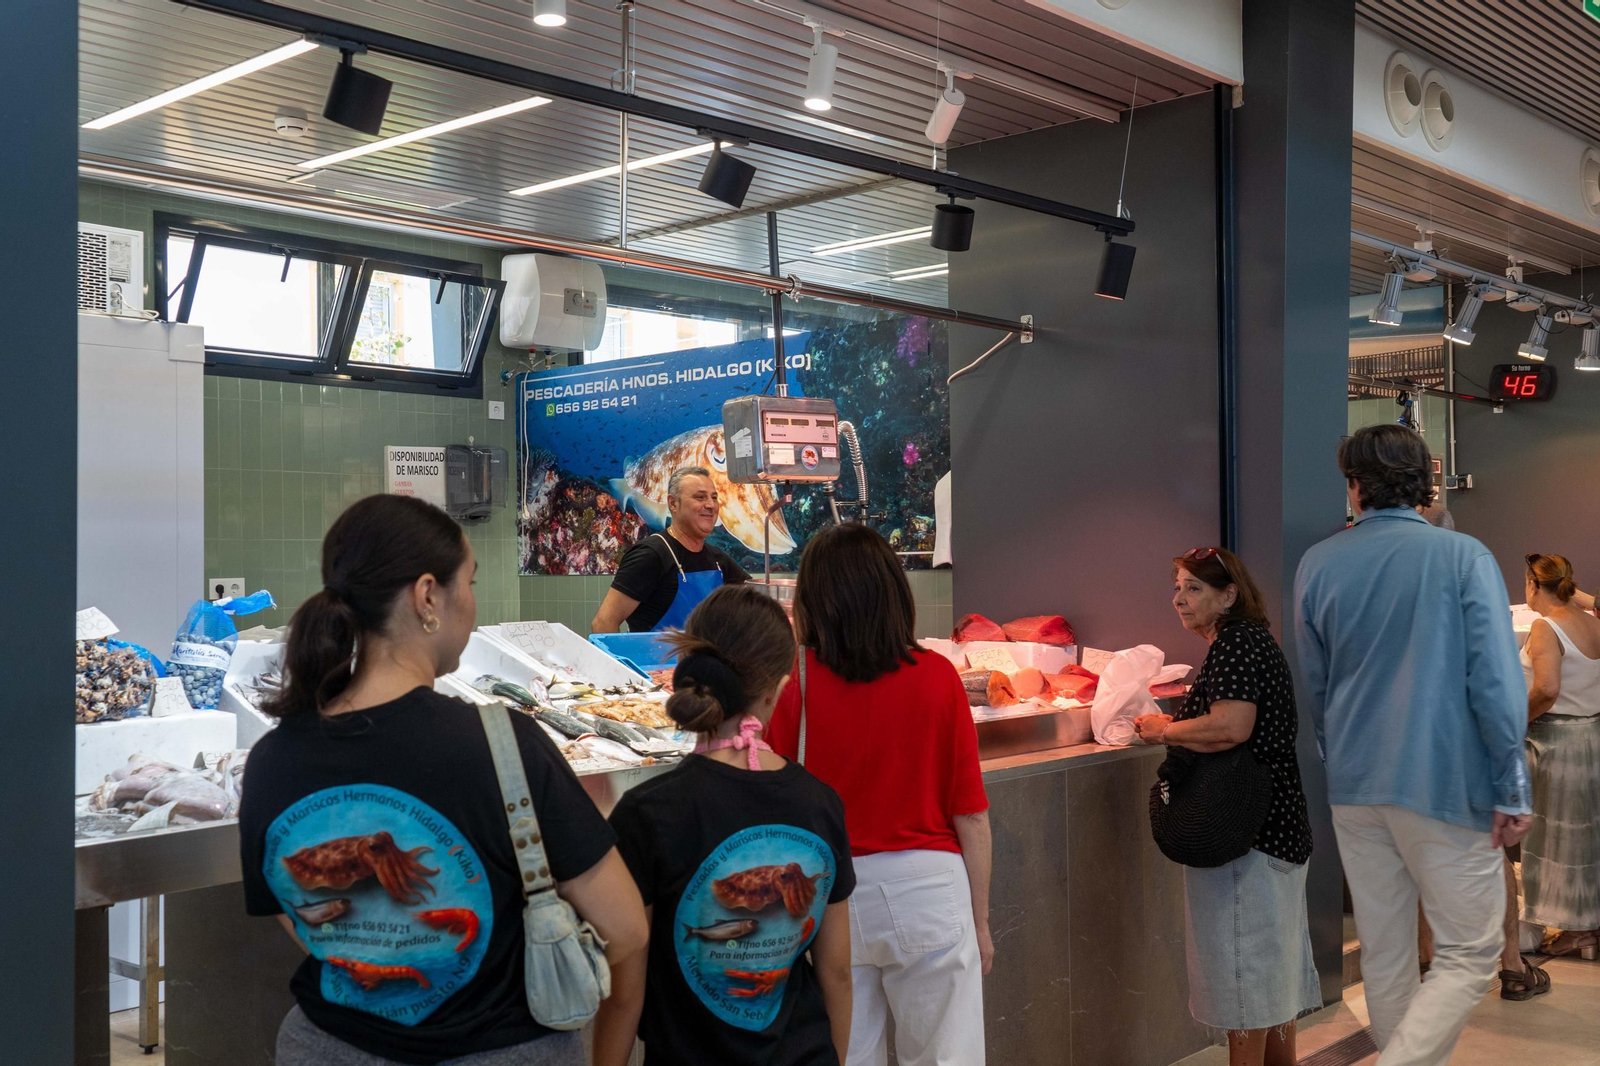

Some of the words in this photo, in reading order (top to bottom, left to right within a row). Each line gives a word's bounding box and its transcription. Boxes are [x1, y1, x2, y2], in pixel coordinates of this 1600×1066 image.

[525, 377, 620, 402] PESCADERÍA
[622, 372, 673, 390] HNOS.
[676, 361, 752, 383] HIDALGO
[756, 353, 812, 377] (KKO)
[1504, 375, 1538, 396] 46
[555, 402, 580, 414] 656
[582, 400, 599, 411] 92
[601, 398, 618, 409] 54
[621, 395, 637, 407] 21
[389, 451, 445, 463] DISPONIBILIDAD
[396, 465, 406, 475] DE
[407, 465, 439, 476] MARISCO
[286, 793, 341, 828] Mariscos
[343, 789, 408, 813] Hermanos
[408, 806, 454, 849] Hidalgo
[448, 845, 482, 884] (Kiko)
[686, 860, 720, 902] Pescados
[719, 853, 728, 863] y
[724, 830, 764, 856] Mariscos
[765, 828, 813, 848] Hermanos
[377, 923, 386, 932] 92
[400, 924, 411, 935] 21
[382, 939, 392, 948] de
[395, 934, 440, 950] pedidos
[762, 939, 777, 948] 656
[778, 937, 786, 945] 92
[710, 950, 731, 959] Para
[686, 955, 720, 1001] Mercado
[719, 999, 741, 1016] San
[409, 979, 456, 1016] puesto
